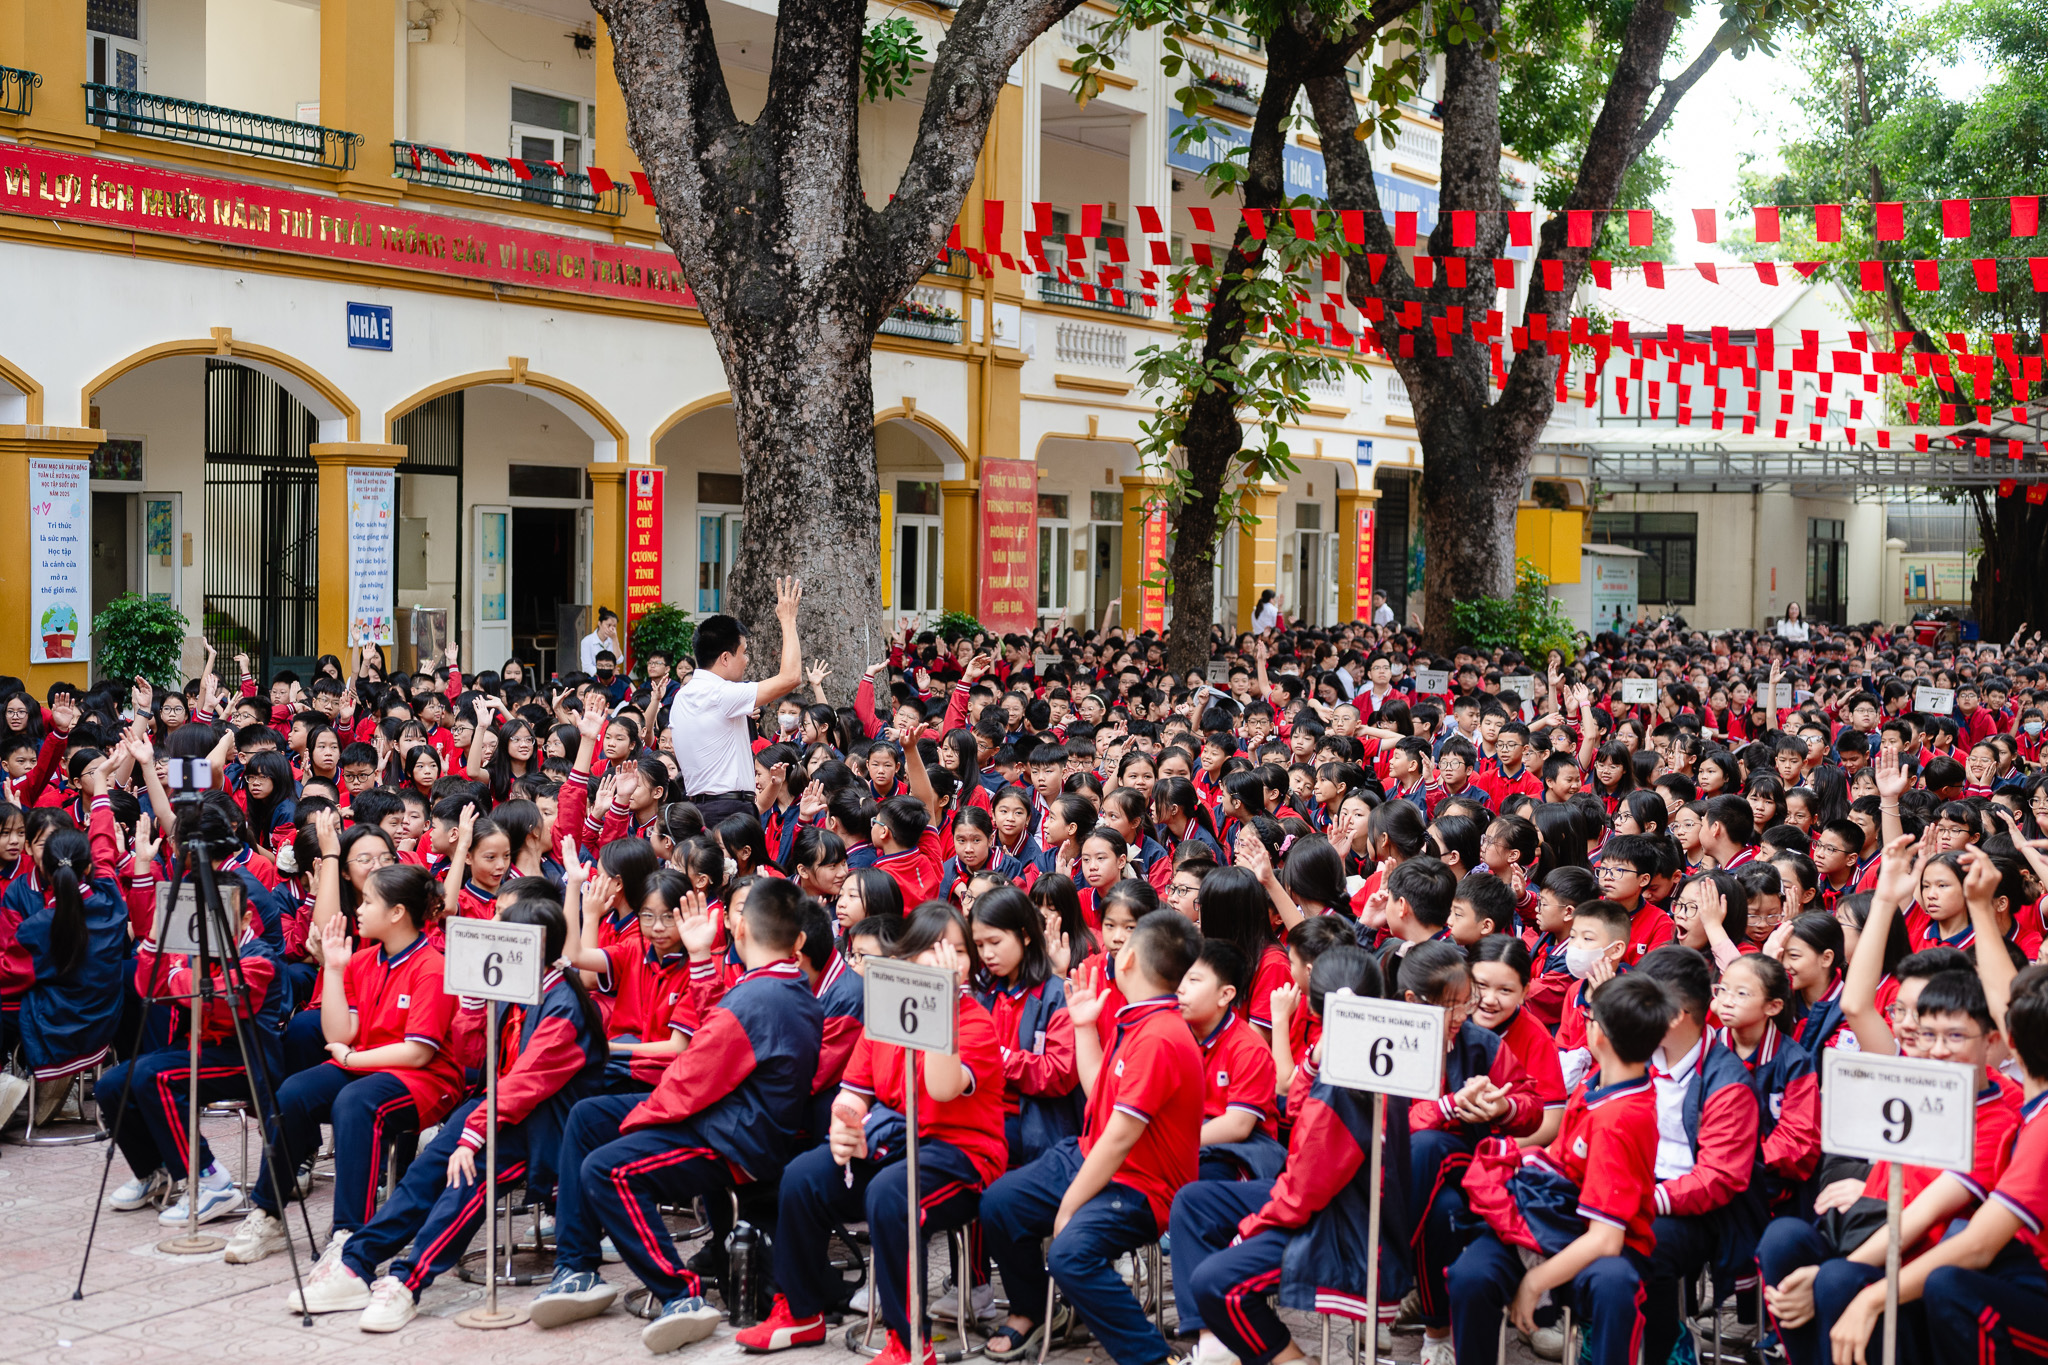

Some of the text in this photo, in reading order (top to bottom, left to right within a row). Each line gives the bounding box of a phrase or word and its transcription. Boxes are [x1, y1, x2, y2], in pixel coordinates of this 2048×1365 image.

[1290, 157, 1312, 189] HÓA
[4, 163, 30, 197] VÌ
[40, 172, 81, 208] LỢI
[90, 173, 134, 211] ÍCH
[142, 187, 206, 223] MƯỜI
[214, 197, 270, 232] NĂM
[278, 207, 313, 239] THÌ
[320, 212, 372, 248] PHẢI
[452, 234, 492, 268] CÂY,
[499, 240, 516, 270] VÌ
[523, 250, 550, 278] LỢI
[556, 249, 586, 279] ÍCH
[592, 258, 642, 287] TRĂM
[647, 265, 685, 294] NĂM
[350, 311, 390, 340] NHÀ E
[1008, 473, 1017, 488] VÀ
[1018, 474, 1031, 489] TRÒ
[637, 498, 652, 511] DÂN
[987, 500, 1032, 514] TRƯỜNG THCS
[637, 514, 653, 528] CHỦ
[48, 534, 58, 542] sức
[60, 535, 78, 543] mạnh.
[639, 531, 650, 545] KỶ
[990, 524, 1029, 539] HOÀNG LIỆT
[48, 548, 72, 556] Học tập
[632, 551, 658, 562] CƯƠNG
[992, 548, 1026, 563] VĂN MINH
[50, 573, 61, 581] mở
[635, 566, 654, 579] TÌNH
[1013, 576, 1029, 590] LỊCH
[41, 586, 52, 594] thế
[53, 586, 64, 595] giới
[628, 585, 660, 597] THƯƠNG
[993, 598, 1009, 616] HIỆN
[1211, 670, 1217, 680] 7
[1428, 679, 1435, 689] 9
[1636, 688, 1644, 698] 7
[1931, 698, 1938, 708] 7
[483, 950, 523, 986] 6 A6
[900, 996, 936, 1034] 6 A5
[1336, 1009, 1365, 1021] TRƯỜNG
[1368, 1014, 1385, 1023] THCS
[1369, 1035, 1418, 1077] 6 A4
[1838, 1067, 1876, 1080] TRƯỜNG
[1878, 1073, 1900, 1084] THCS
[1882, 1096, 1944, 1144] 9 A5
